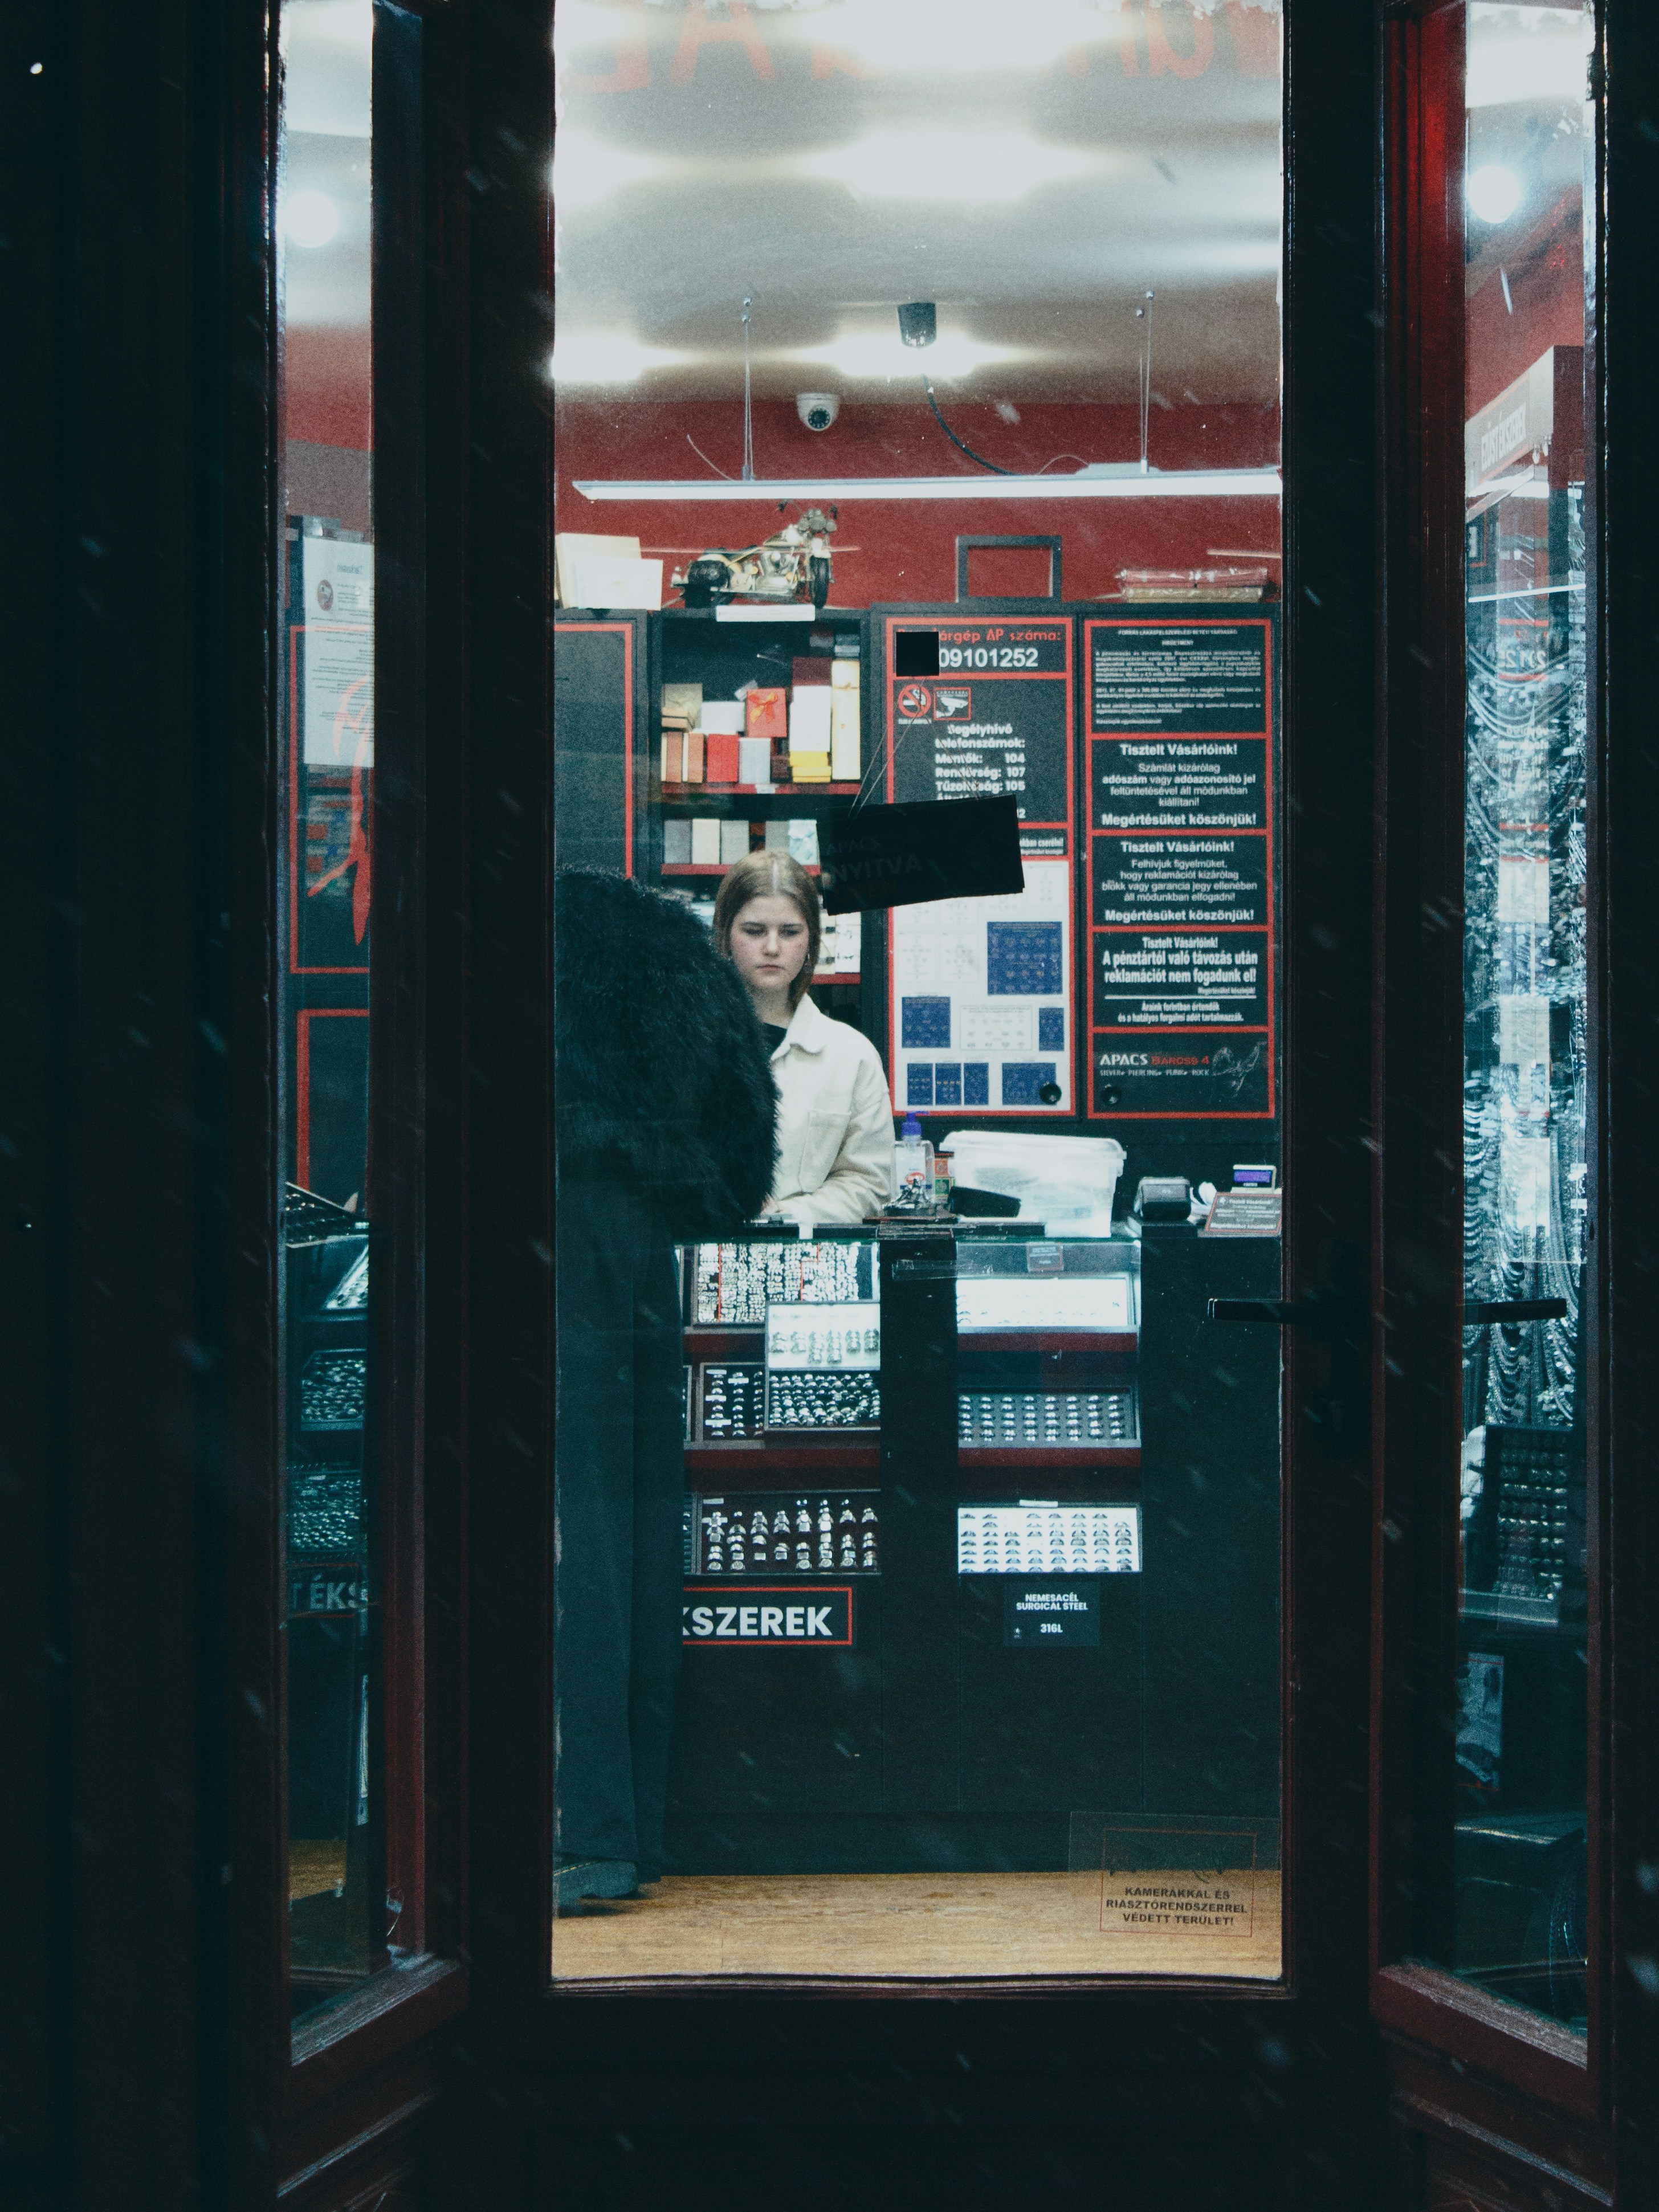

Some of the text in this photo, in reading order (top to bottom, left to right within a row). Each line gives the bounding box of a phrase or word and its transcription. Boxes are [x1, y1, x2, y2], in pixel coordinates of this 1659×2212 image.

[986, 628, 1004, 641] AP
[1009, 630, 1061, 642] száma:
[947, 723, 1013, 737] Segélyhívó
[935, 737, 1026, 748] telefonszámok:
[1119, 743, 1238, 756] Tisztelt Vásárlóink!
[935, 753, 1025, 764] Mentők: 104
[935, 766, 1026, 780] Rendőrség: 107
[1138, 762, 1220, 774] Számlát kizárólag
[1102, 774, 1147, 784] adószám
[1149, 777, 1172, 786] vagy
[1243, 774, 1256, 785] jel
[935, 780, 1025, 794] Tűzoltóság: 105
[1193, 786, 1248, 795] módunkban
[1102, 813, 1256, 827] Megértésüket köszönjük!
[1120, 840, 1235, 853] Tisztelt Vásárlóink!
[1120, 870, 1239, 881] hogy reklamációt kizárólag
[1128, 883, 1150, 892] vagy
[1151, 882, 1191, 892] garancia
[1192, 881, 1212, 892] jegy
[1136, 893, 1189, 901] módunkban
[1105, 908, 1255, 923] Megértésüket köszönjük!
[1143, 937, 1218, 949] Tisztelt Vásárlóink!
[1102, 950, 1258, 968] A pénztártól való távozás után
[1104, 968, 1257, 986] reklamációt nem fogadunk el!
[1100, 1054, 1149, 1066] APACS
[1025, 1592, 1079, 1602] NEMESACÉL
[1016, 1602, 1089, 1610] SURGICAL STEEL
[1040, 1623, 1063, 1633] 316L
[1124, 1887, 1230, 1900] KAMERÁKKAL ÉS
[1105, 1900, 1248, 1913] RIASZTÓRENDSZERREL
[1123, 1912, 1234, 1925] VÉDETT TERÜLET!
